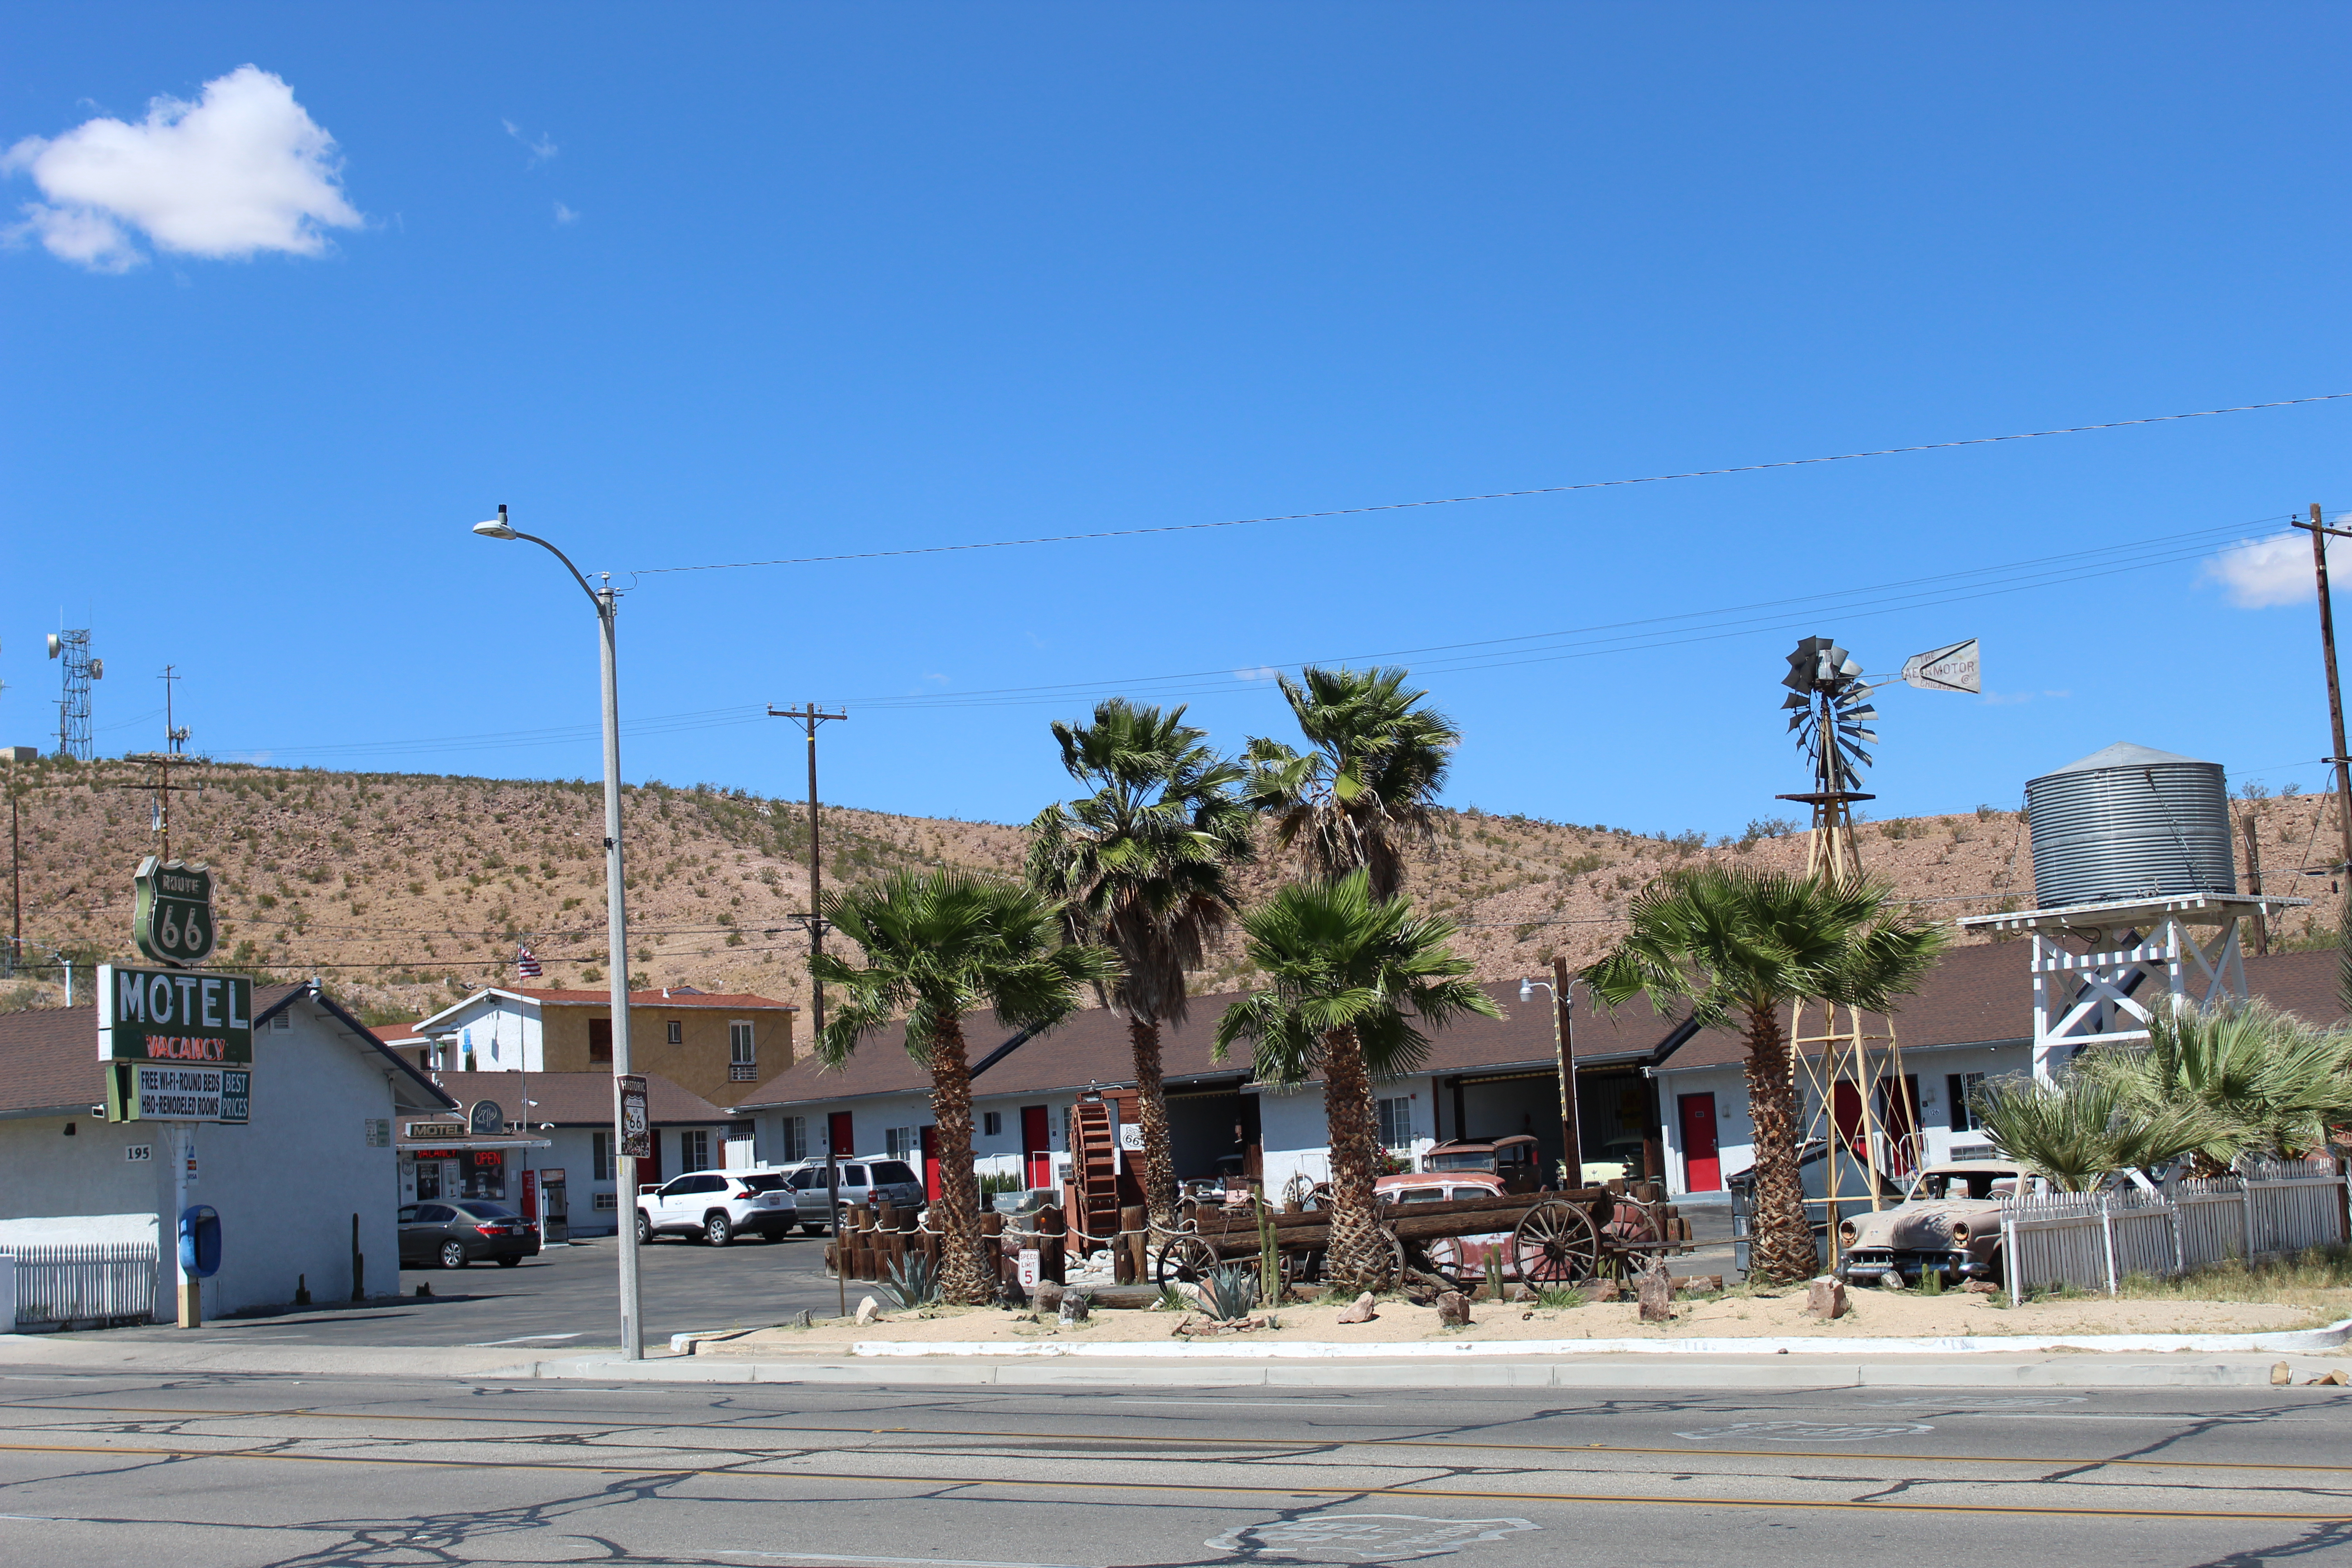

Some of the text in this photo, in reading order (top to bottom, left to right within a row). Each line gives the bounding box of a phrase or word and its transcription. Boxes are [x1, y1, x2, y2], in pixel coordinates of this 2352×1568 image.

[1918, 652, 1935, 663] THE
[1906, 661, 1974, 678] AERMOTOR
[163, 875, 201, 894] ROUTE
[162, 905, 203, 951] 66
[120, 971, 248, 1029] MOTEL
[146, 1034, 225, 1061] VACANCY
[141, 1071, 158, 1090] FREE
[204, 1073, 220, 1093] BEDS
[225, 1073, 246, 1093] BEST
[621, 1080, 646, 1092] HISTORIC
[197, 1096, 219, 1116] ROOMS
[222, 1098, 248, 1116] PRICES
[630, 1114, 642, 1129] 66
[414, 1125, 462, 1136] MOTEL
[1125, 1135, 1140, 1146] 66
[128, 1147, 149, 1159] 195
[417, 1149, 457, 1158] VACANCY
[475, 1152, 501, 1165] OPEN
[1025, 1270, 1033, 1284] 5
[1374, 1523, 1494, 1549] HISTORIC
